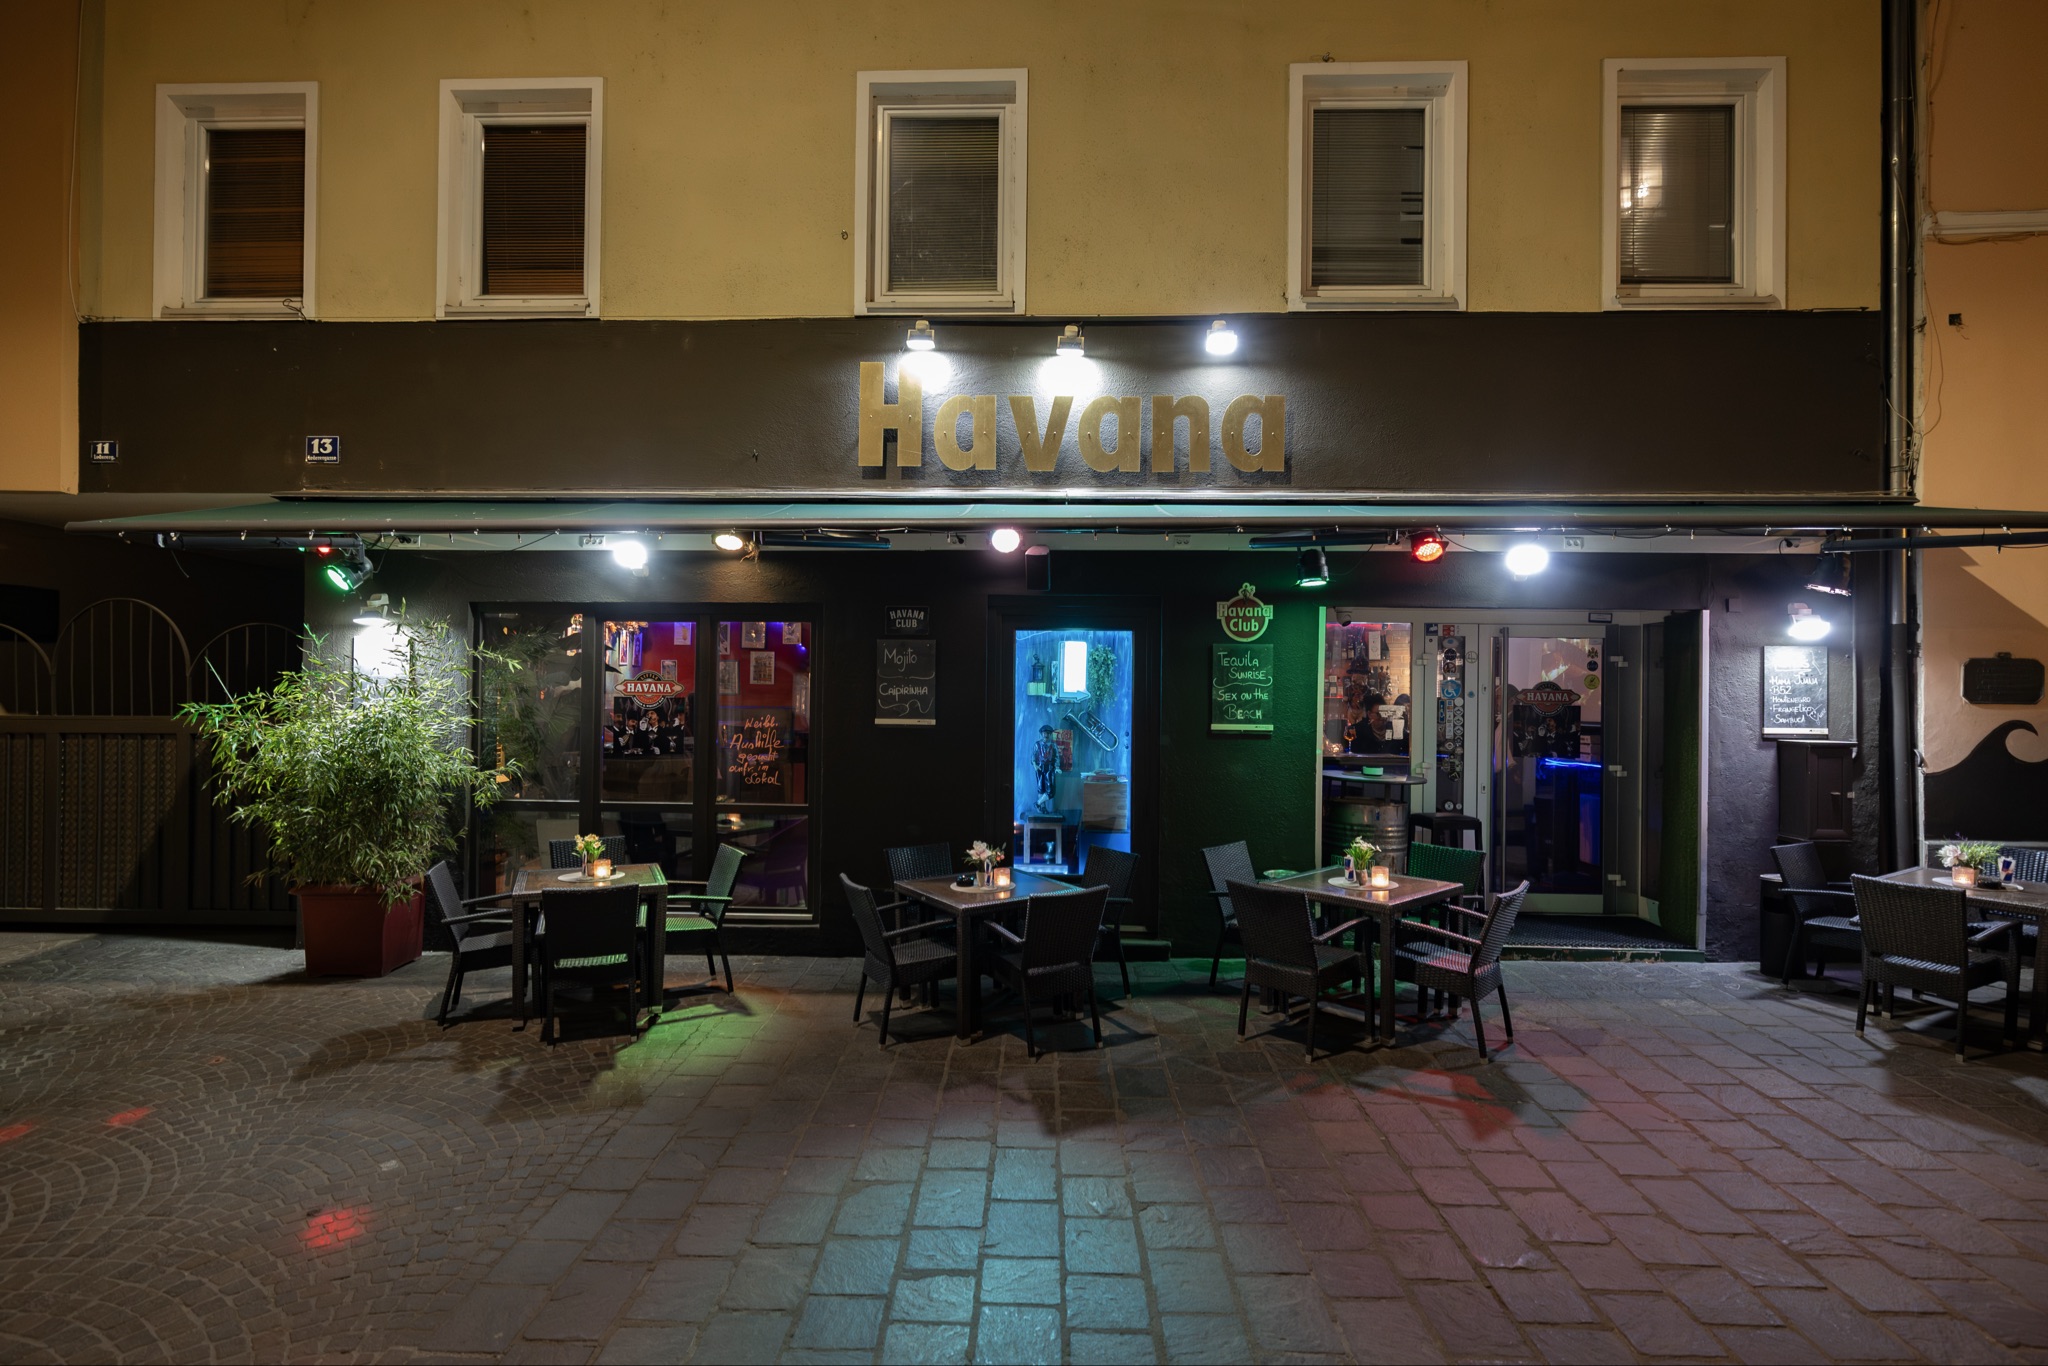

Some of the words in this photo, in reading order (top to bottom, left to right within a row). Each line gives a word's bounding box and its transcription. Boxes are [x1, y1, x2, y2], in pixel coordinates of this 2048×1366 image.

[858, 361, 1286, 473] Havana
[95, 442, 110, 454] 11
[311, 438, 333, 454] 13
[889, 608, 925, 620] HAVANA
[1219, 603, 1271, 617] Havana
[895, 619, 918, 628] CLUB
[1229, 618, 1260, 632] Club
[883, 647, 918, 672] Mojito
[626, 683, 672, 693] HAVANA
[1770, 685, 1793, 696] B52
[1217, 689, 1239, 701] SEX
[1526, 692, 1570, 702] HAVANA
[729, 728, 784, 757] Aushilfe
[745, 771, 781, 785] Lokal
